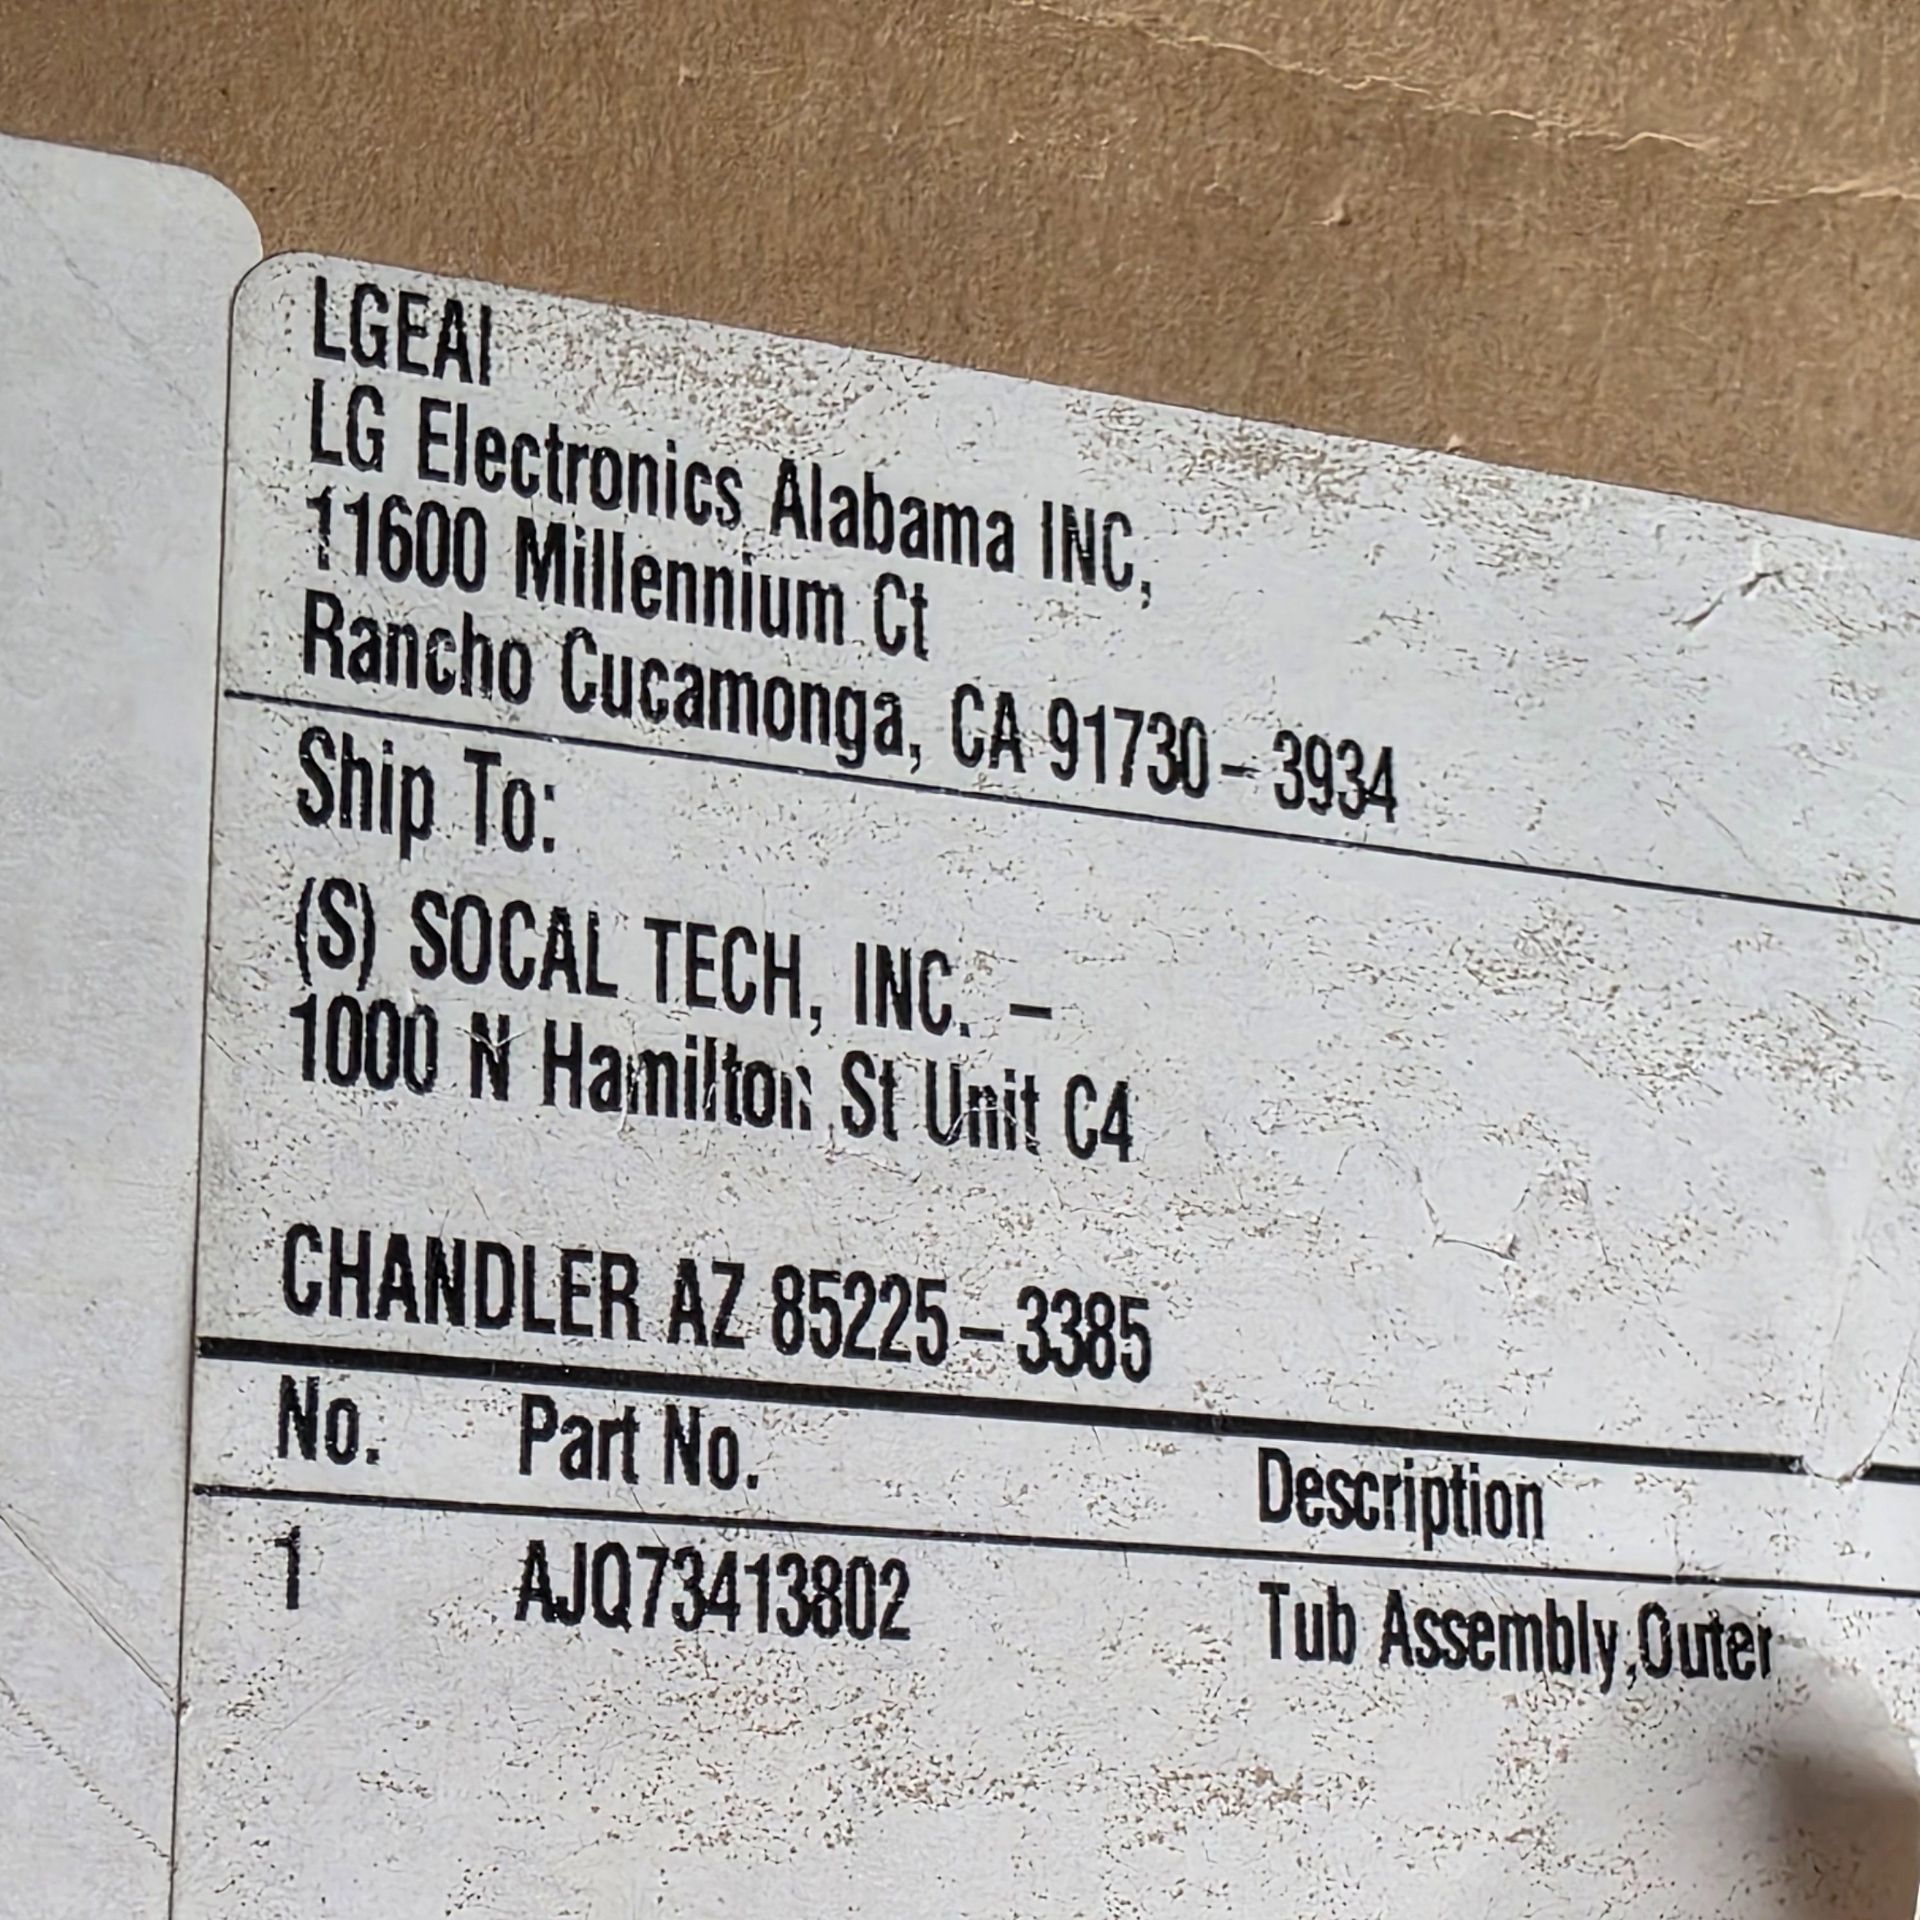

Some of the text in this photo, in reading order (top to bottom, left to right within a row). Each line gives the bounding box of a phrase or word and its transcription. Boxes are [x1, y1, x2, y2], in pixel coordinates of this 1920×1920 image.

[313, 276, 492, 387] LGEAI
[310, 379, 1151, 609] LG Electronics Alabama INC,
[307, 487, 929, 660] 11600 Millennium Ct
[303, 589, 532, 704] Rancho
[561, 626, 923, 773] Cucamonga,
[952, 683, 1026, 773] CA
[297, 726, 556, 860] Ship To:
[296, 877, 376, 991] (S)
[410, 889, 618, 998] SOCAL
[644, 917, 822, 1036] TECH,
[855, 942, 971, 1037] INC.
[289, 993, 1133, 1163] 1000 N Hamilton St Unit C4
[282, 1223, 645, 1342] CHANDLER
[667, 1258, 745, 1350] AZ
[276, 1374, 759, 1490] No. Part No.
[1258, 1447, 1545, 1551] Description
[274, 1525, 300, 1610] 1
[514, 1540, 910, 1641] AJQ73413802
[1259, 1582, 1356, 1665] Tub
